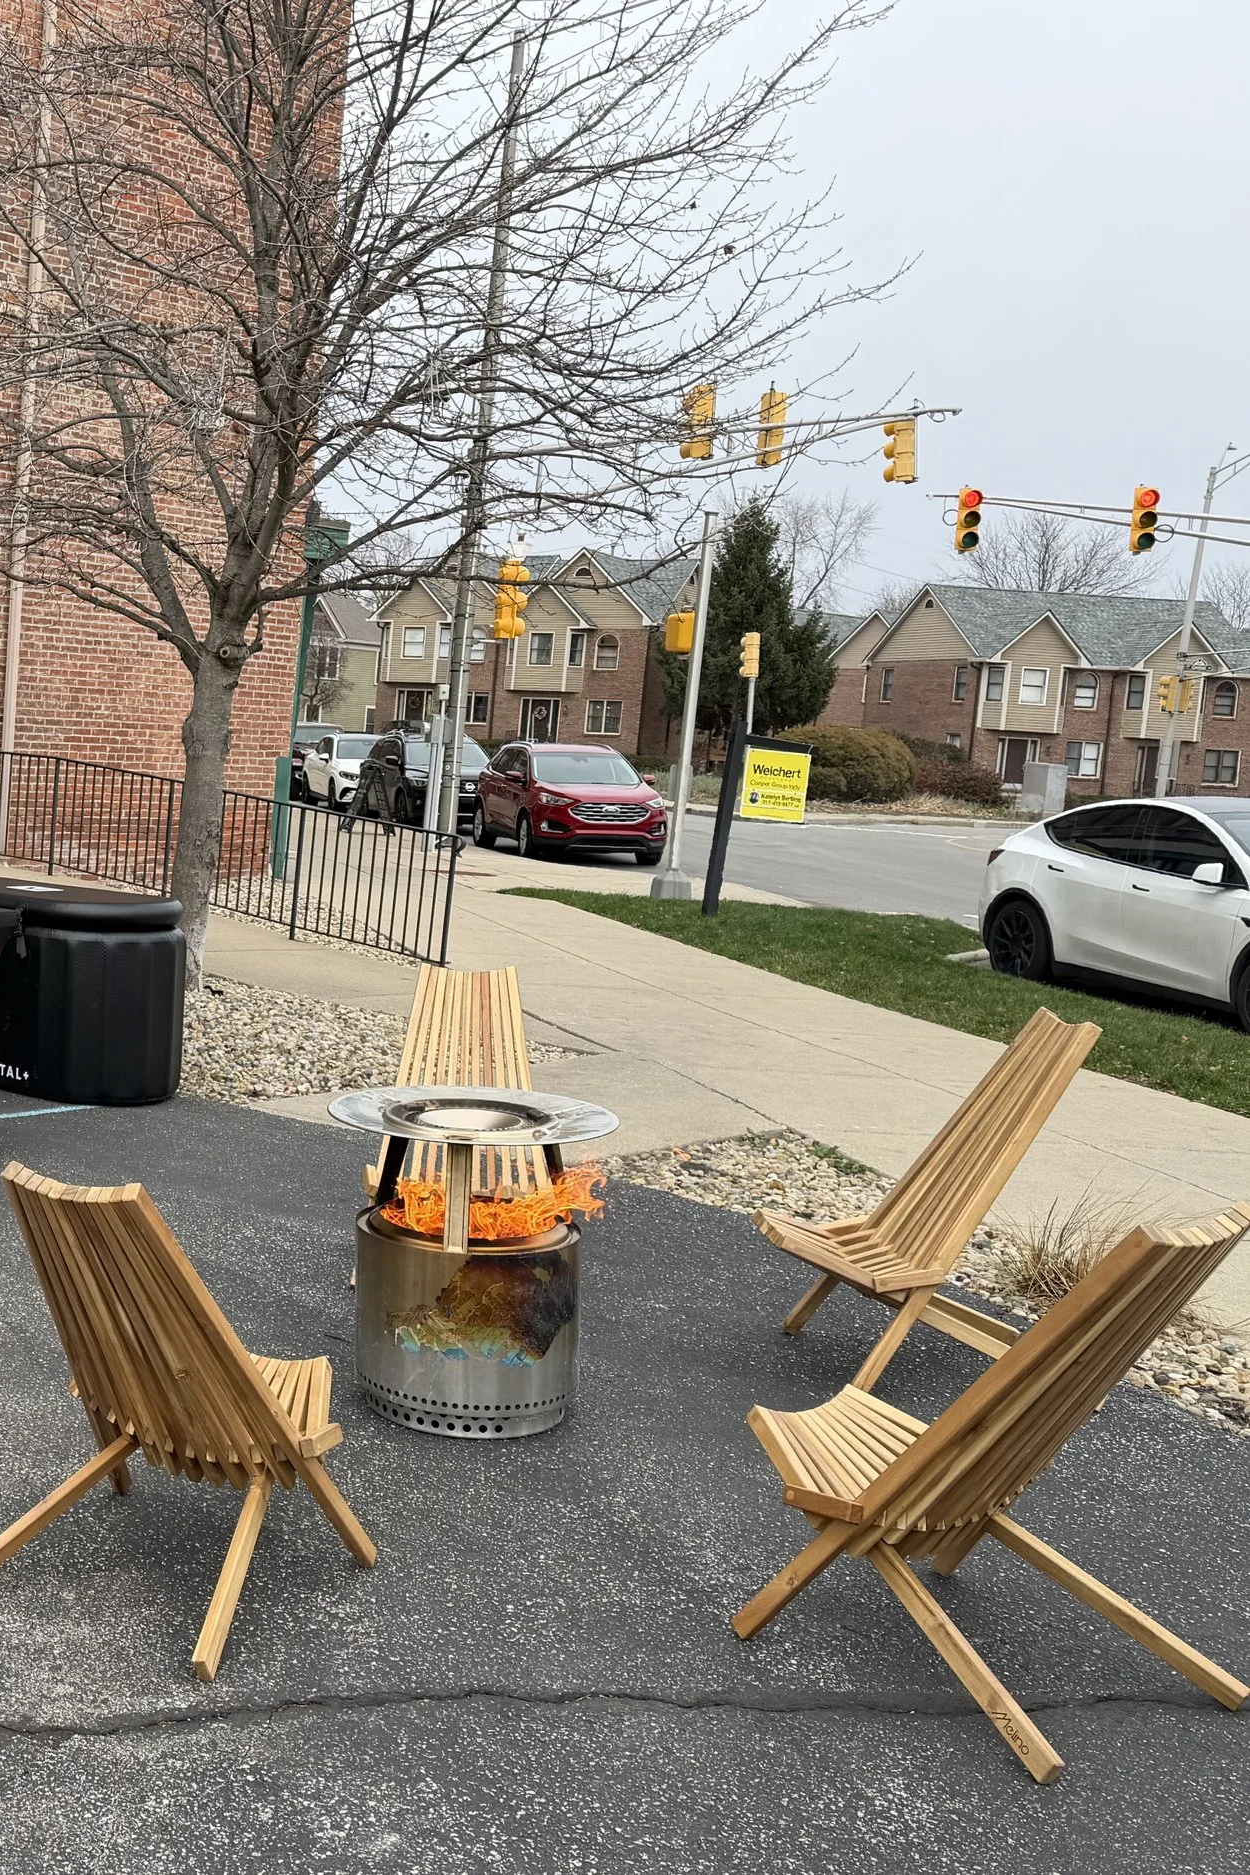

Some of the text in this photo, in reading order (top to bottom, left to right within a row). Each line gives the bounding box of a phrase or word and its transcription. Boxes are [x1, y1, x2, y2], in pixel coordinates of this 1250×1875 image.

[753, 763, 802, 778] Weichert
[771, 781, 788, 790] Group
[991, 1711, 1030, 1756] Melino
